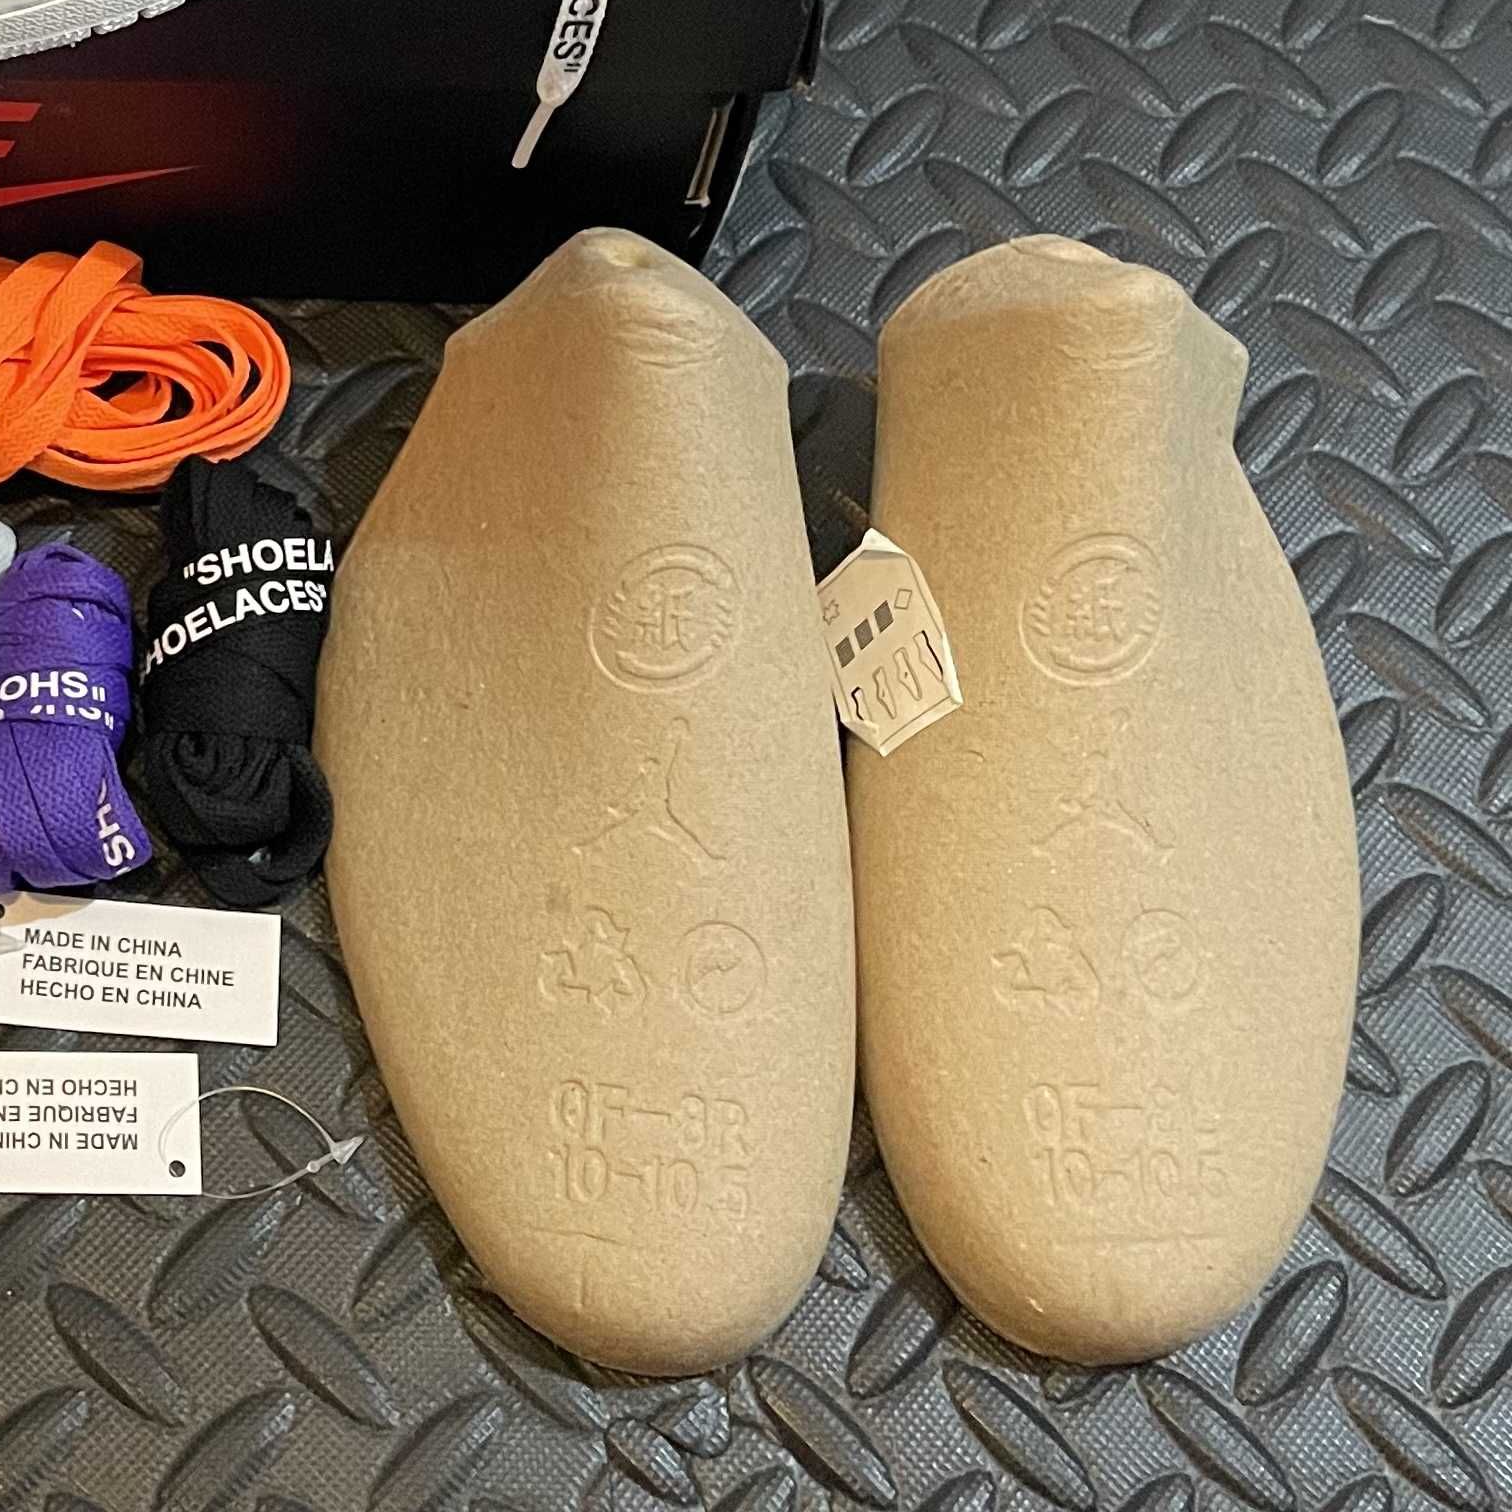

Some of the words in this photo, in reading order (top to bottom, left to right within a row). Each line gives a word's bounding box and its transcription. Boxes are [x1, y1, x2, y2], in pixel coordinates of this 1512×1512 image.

[142, 580, 327, 676] HOELACES"
[24, 928, 84, 950] MADE
[91, 935, 110, 952] IN
[118, 937, 182, 958] CHINA
[22, 954, 128, 979] FABRIQUE
[136, 964, 163, 982] EN
[170, 967, 235, 986] CHINE
[20, 979, 94, 1001] HECHO
[102, 987, 128, 1003] EN
[136, 989, 203, 1010] CHINA
[26, 1079, 54, 1096] EN
[62, 1079, 137, 1097] HECHO
[29, 1104, 138, 1123] FABRIQUE
[49, 1132, 69, 1149] IN
[76, 1132, 138, 1150] MADE
